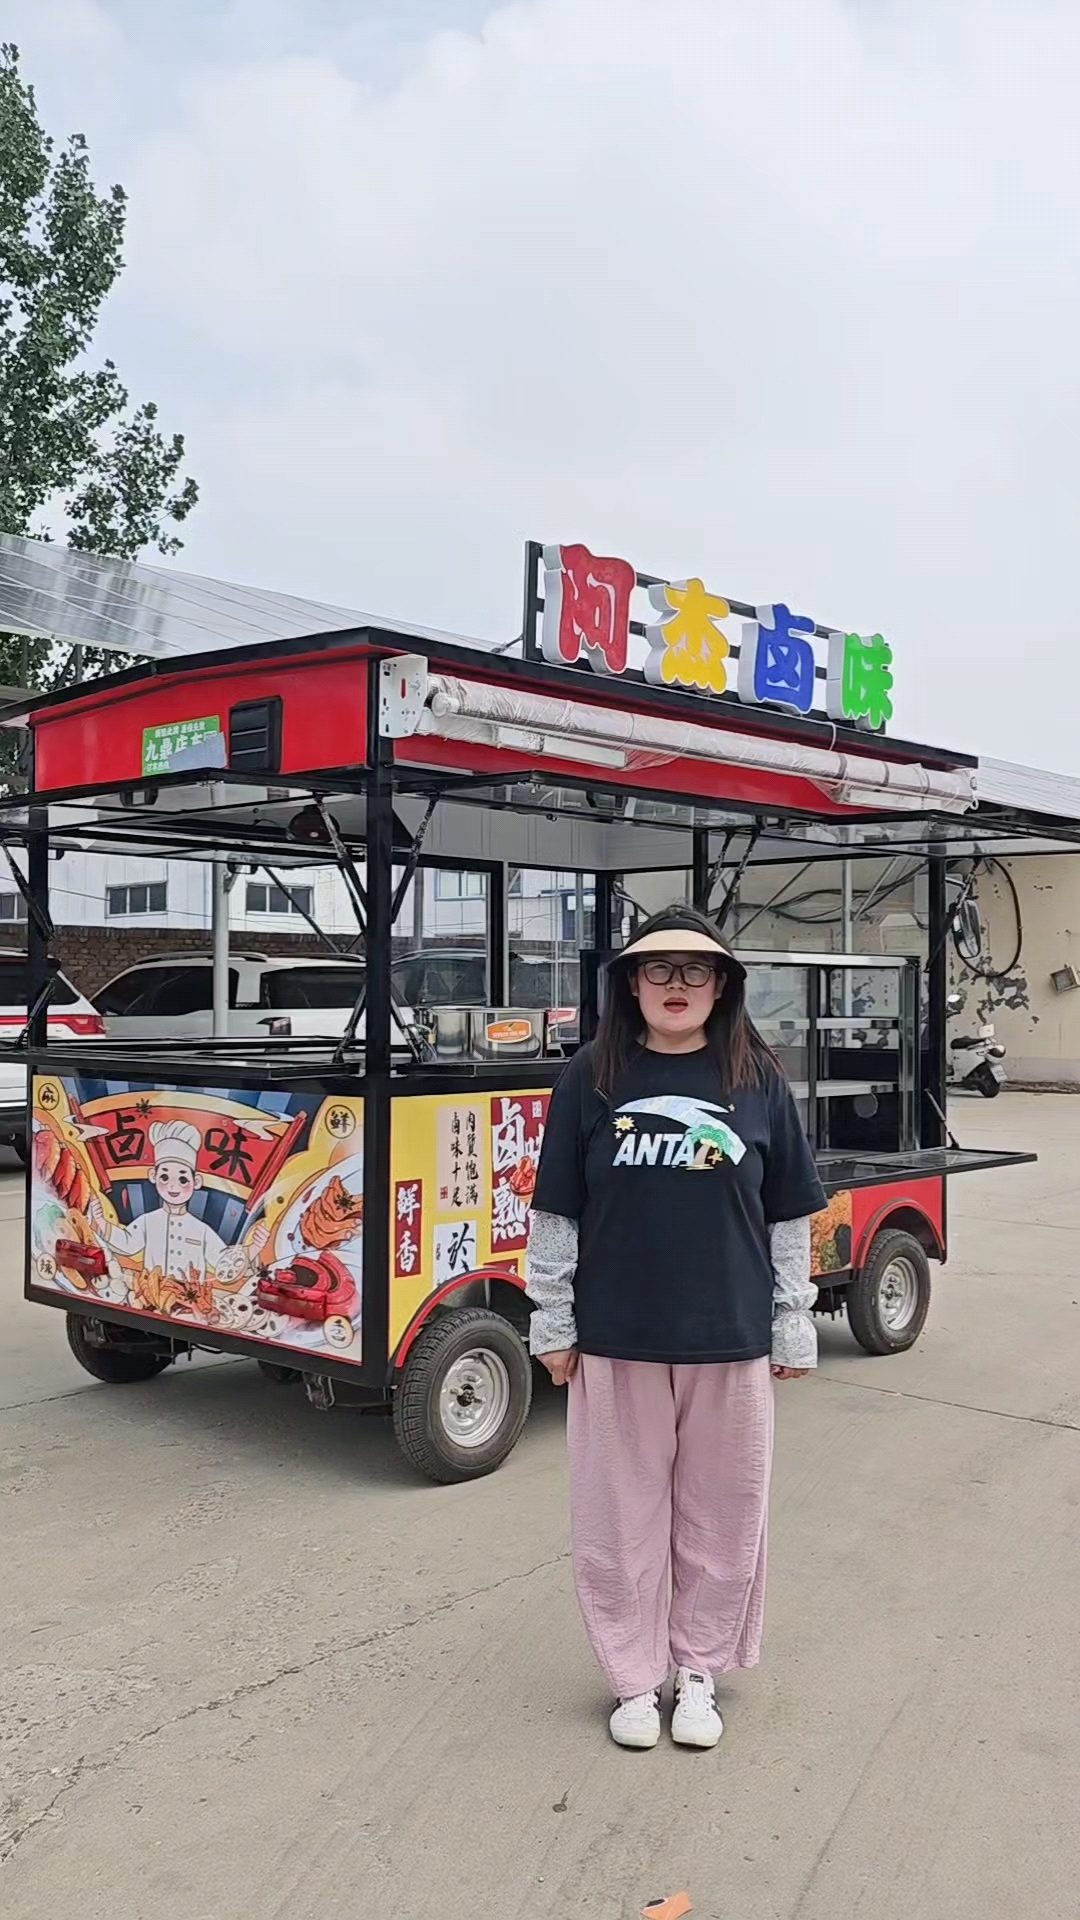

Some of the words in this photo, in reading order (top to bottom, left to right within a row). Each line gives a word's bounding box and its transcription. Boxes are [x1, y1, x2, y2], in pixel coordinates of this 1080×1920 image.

[543, 544, 893, 729] 阿杰卤味
[42, 1086, 56, 1103] 麻
[331, 1110, 351, 1133] 鲜
[105, 1112, 254, 1184] 卤味
[612, 1133, 700, 1166] ANTA
[396, 1183, 420, 1272] 鲜香
